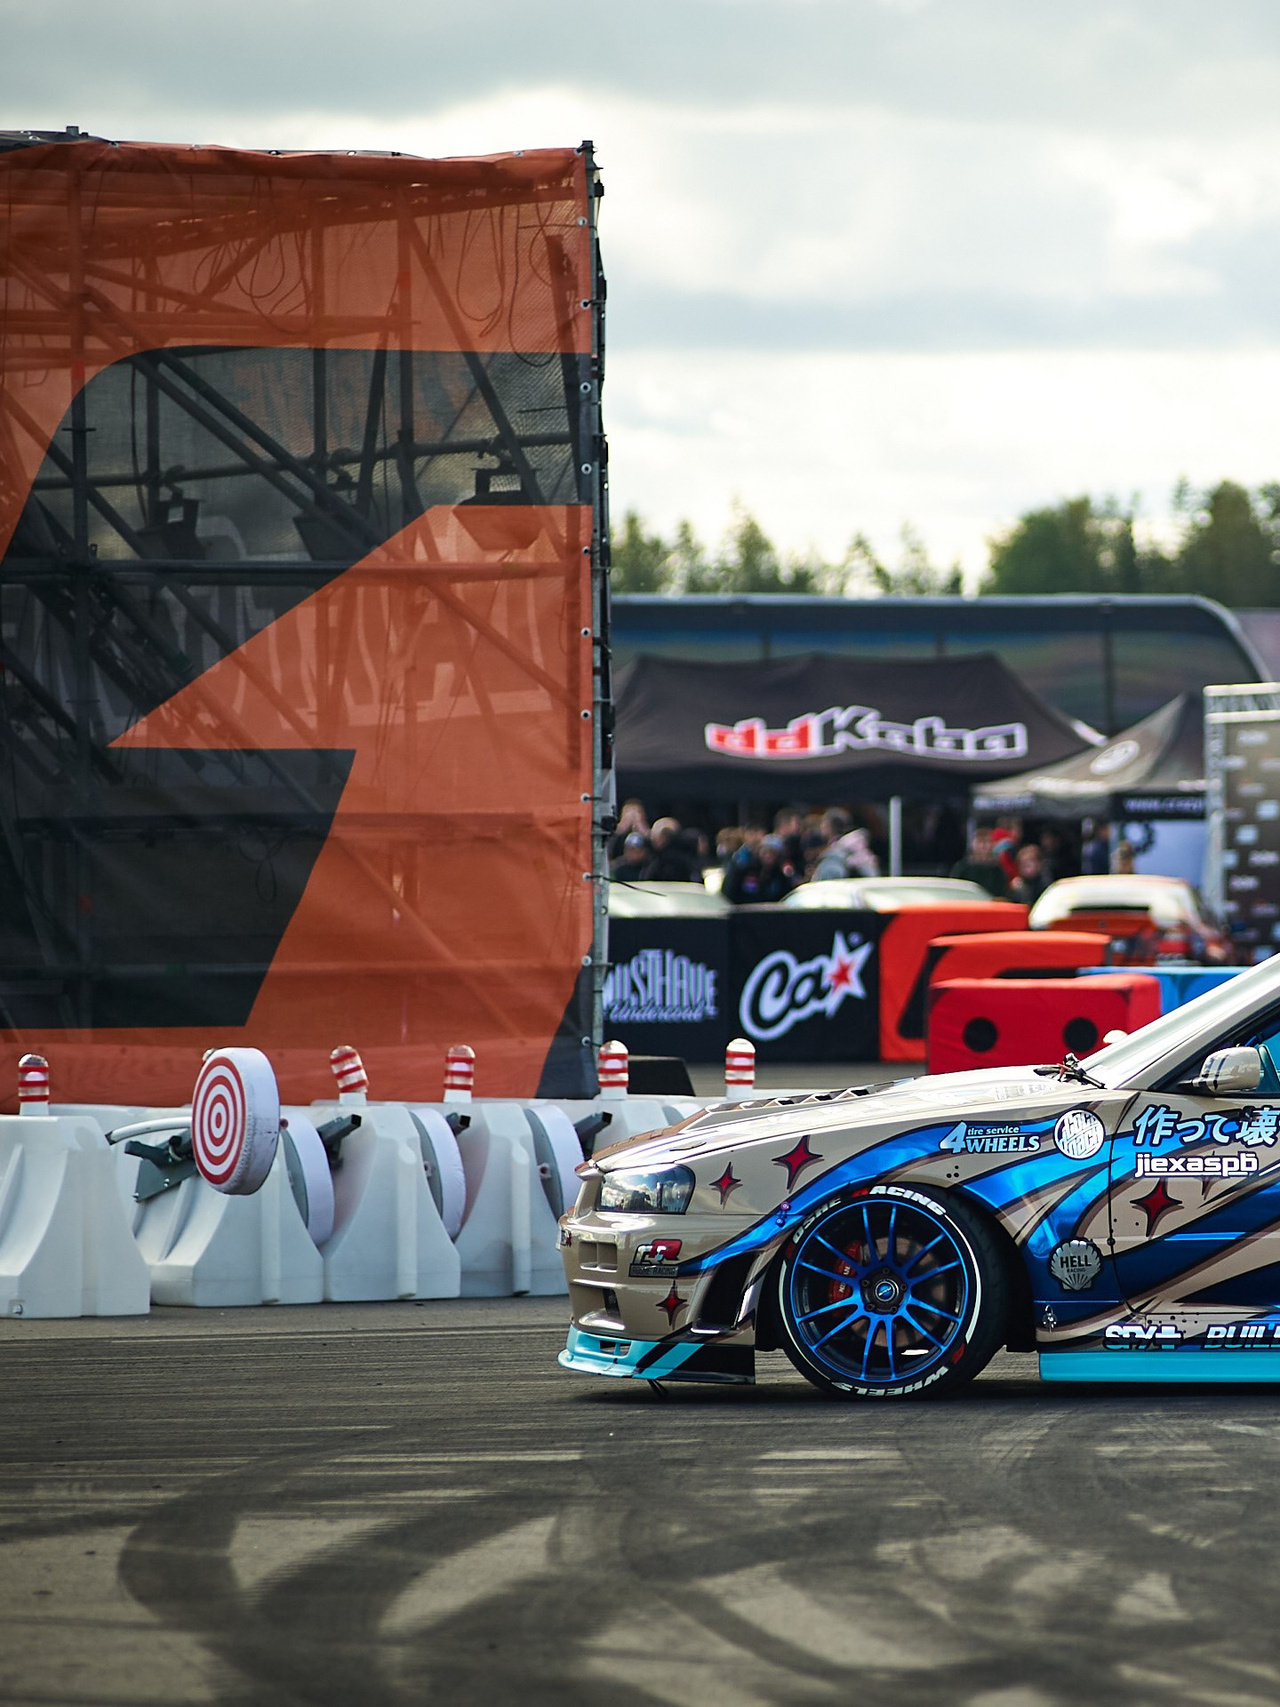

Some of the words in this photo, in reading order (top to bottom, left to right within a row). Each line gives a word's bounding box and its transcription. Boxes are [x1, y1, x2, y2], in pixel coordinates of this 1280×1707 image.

[967, 1127, 984, 1136] tire
[986, 1125, 1020, 1135] service
[966, 1136, 1041, 1154] WHEELS
[1060, 1255, 1092, 1268] HELL
[831, 1365, 949, 1397] WHEELS
